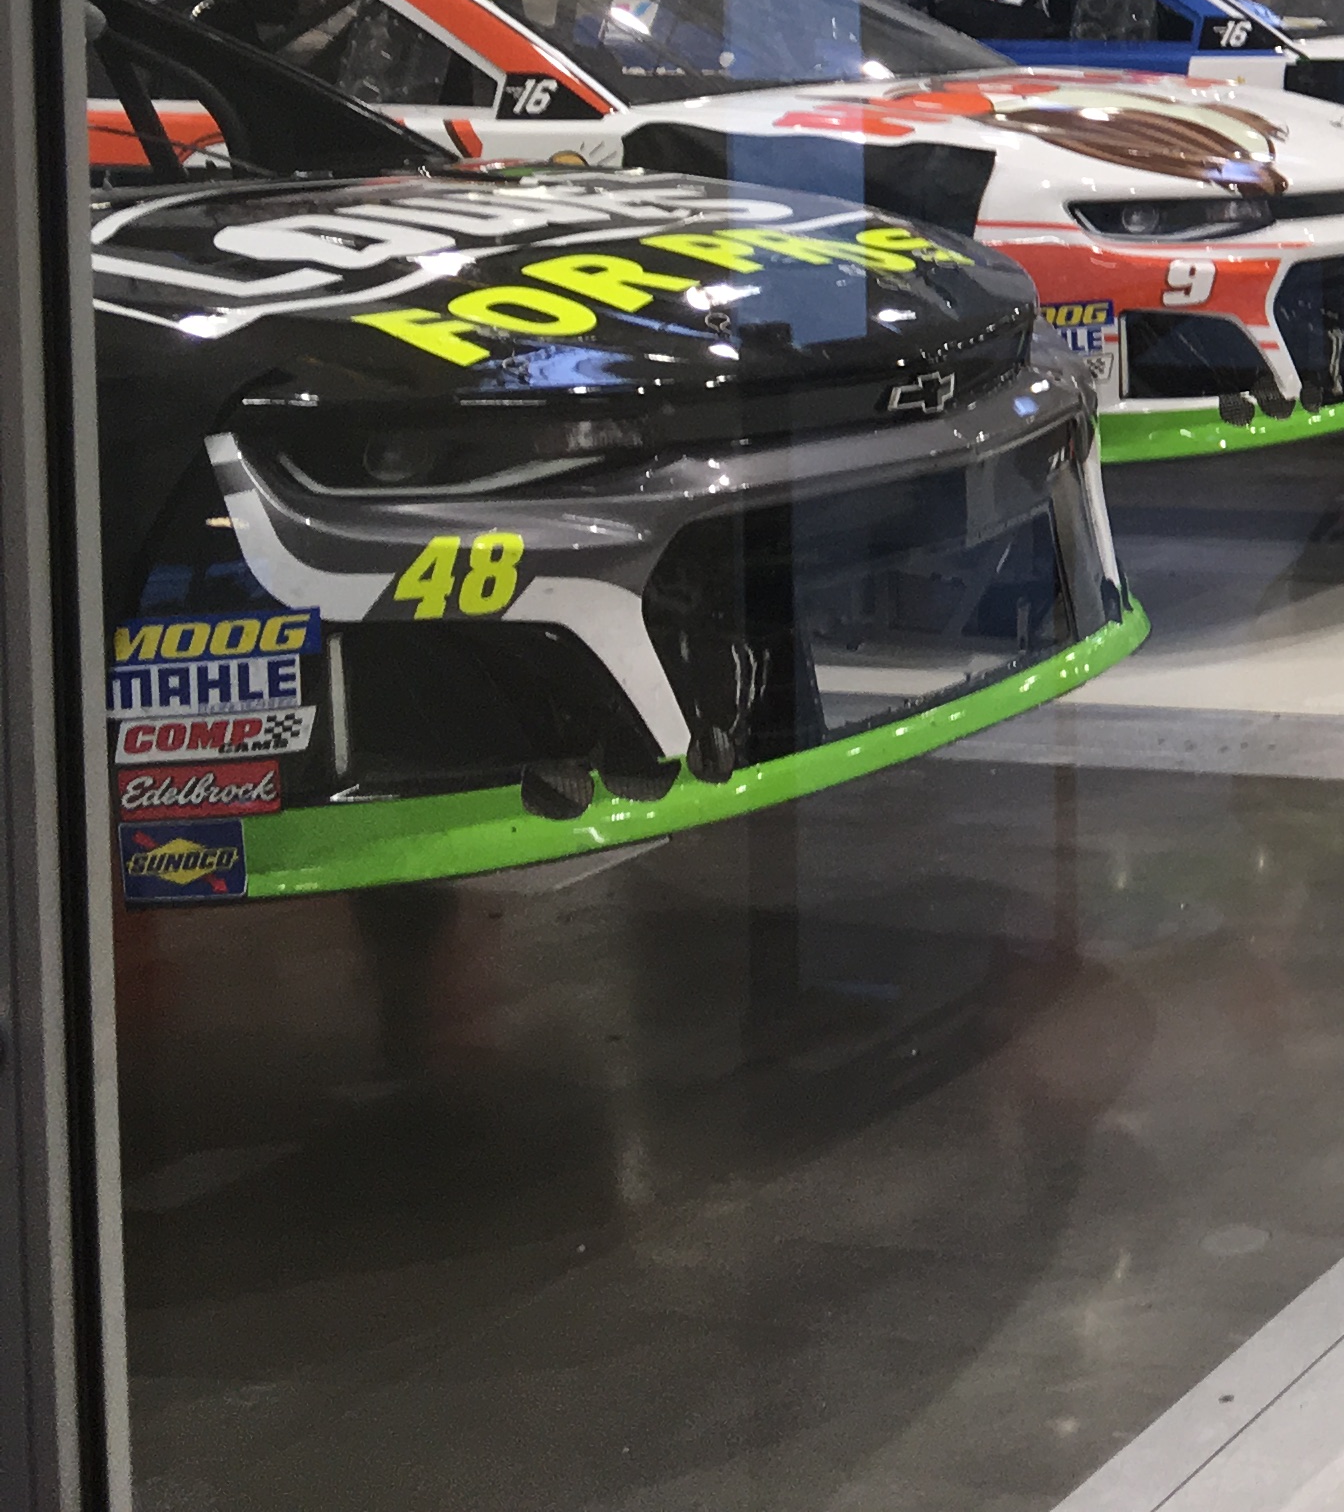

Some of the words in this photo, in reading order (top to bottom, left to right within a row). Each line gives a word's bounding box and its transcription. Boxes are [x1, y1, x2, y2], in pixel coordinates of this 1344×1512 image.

[1220, 20, 1253, 48] 16
[512, 78, 558, 115] 16
[1162, 258, 1217, 307] 9
[352, 253, 700, 367] FOR
[393, 532, 526, 620] 48
[114, 614, 309, 662] MOOG
[106, 659, 297, 710] MAHLE
[123, 717, 263, 755] COMP
[122, 770, 277, 810] Edelbrock
[127, 847, 240, 875] SUNOCO
